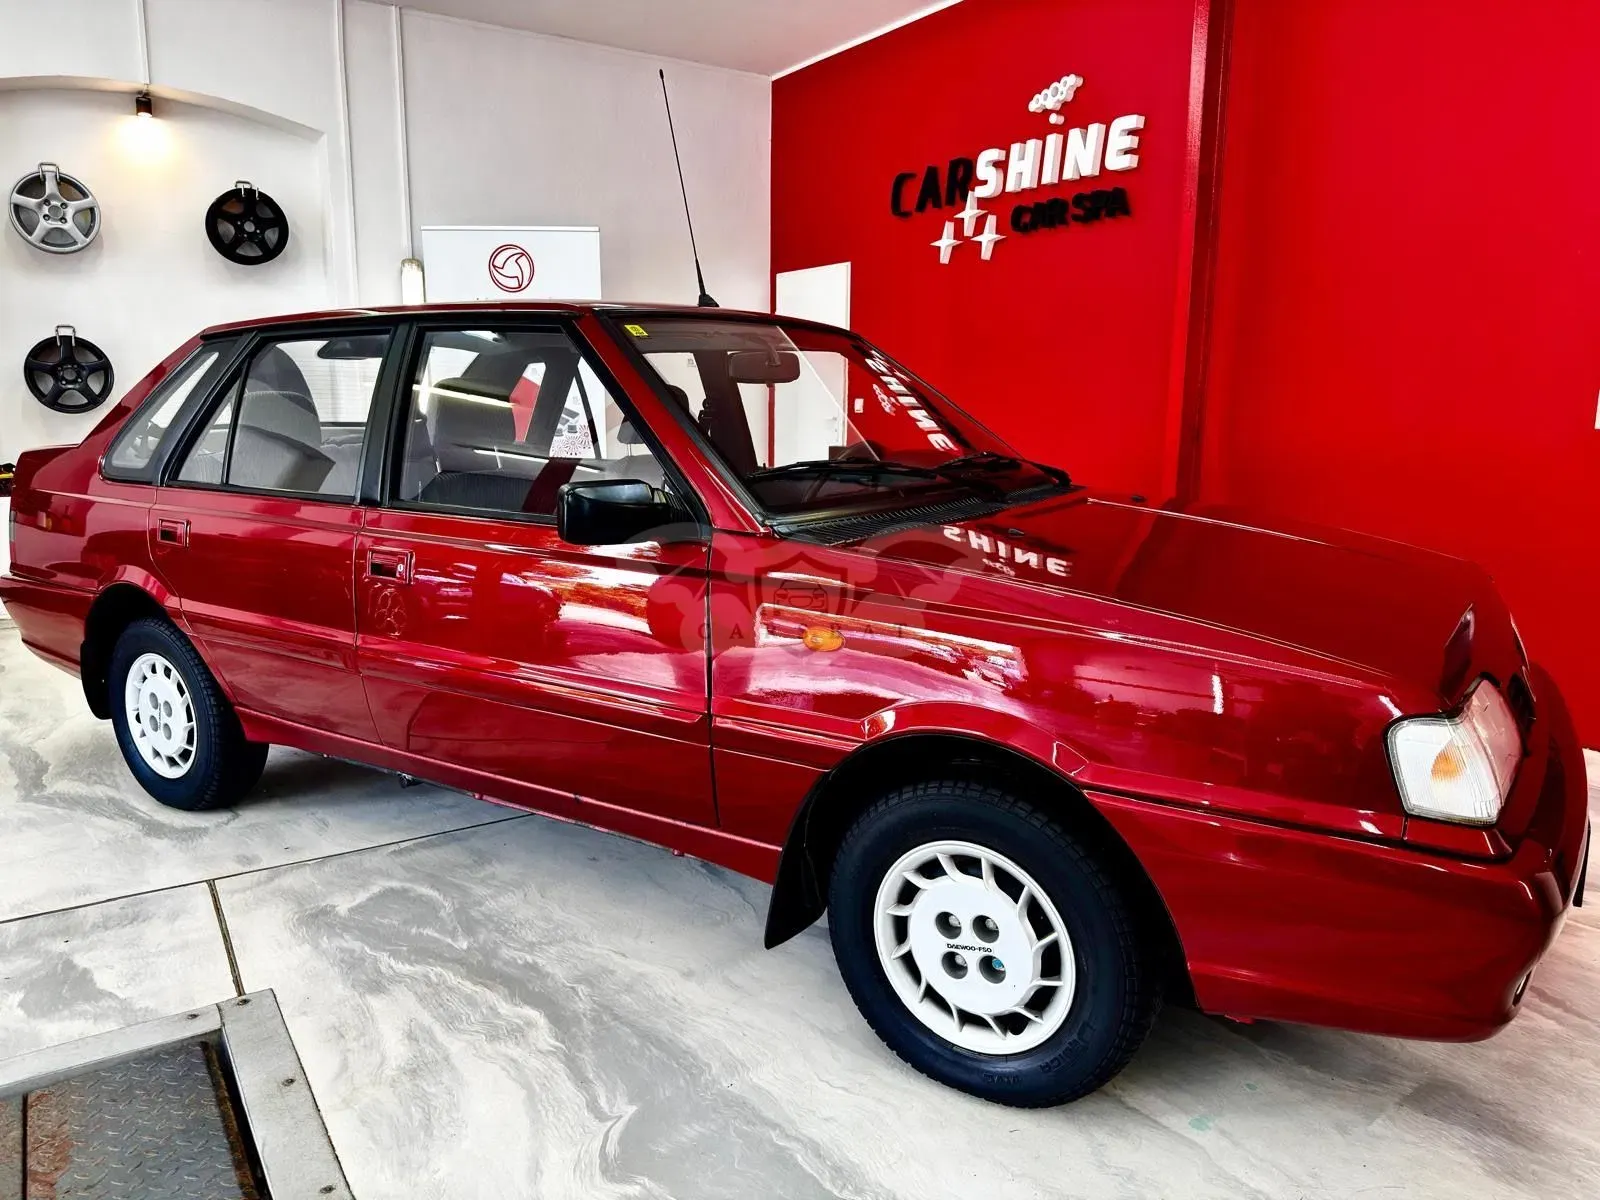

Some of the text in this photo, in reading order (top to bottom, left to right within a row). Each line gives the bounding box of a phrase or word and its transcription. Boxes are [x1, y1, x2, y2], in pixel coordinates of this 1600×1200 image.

[1010, 188, 1130, 233] CAR SPA
[946, 943, 993, 953] DAEWOO-FSO
